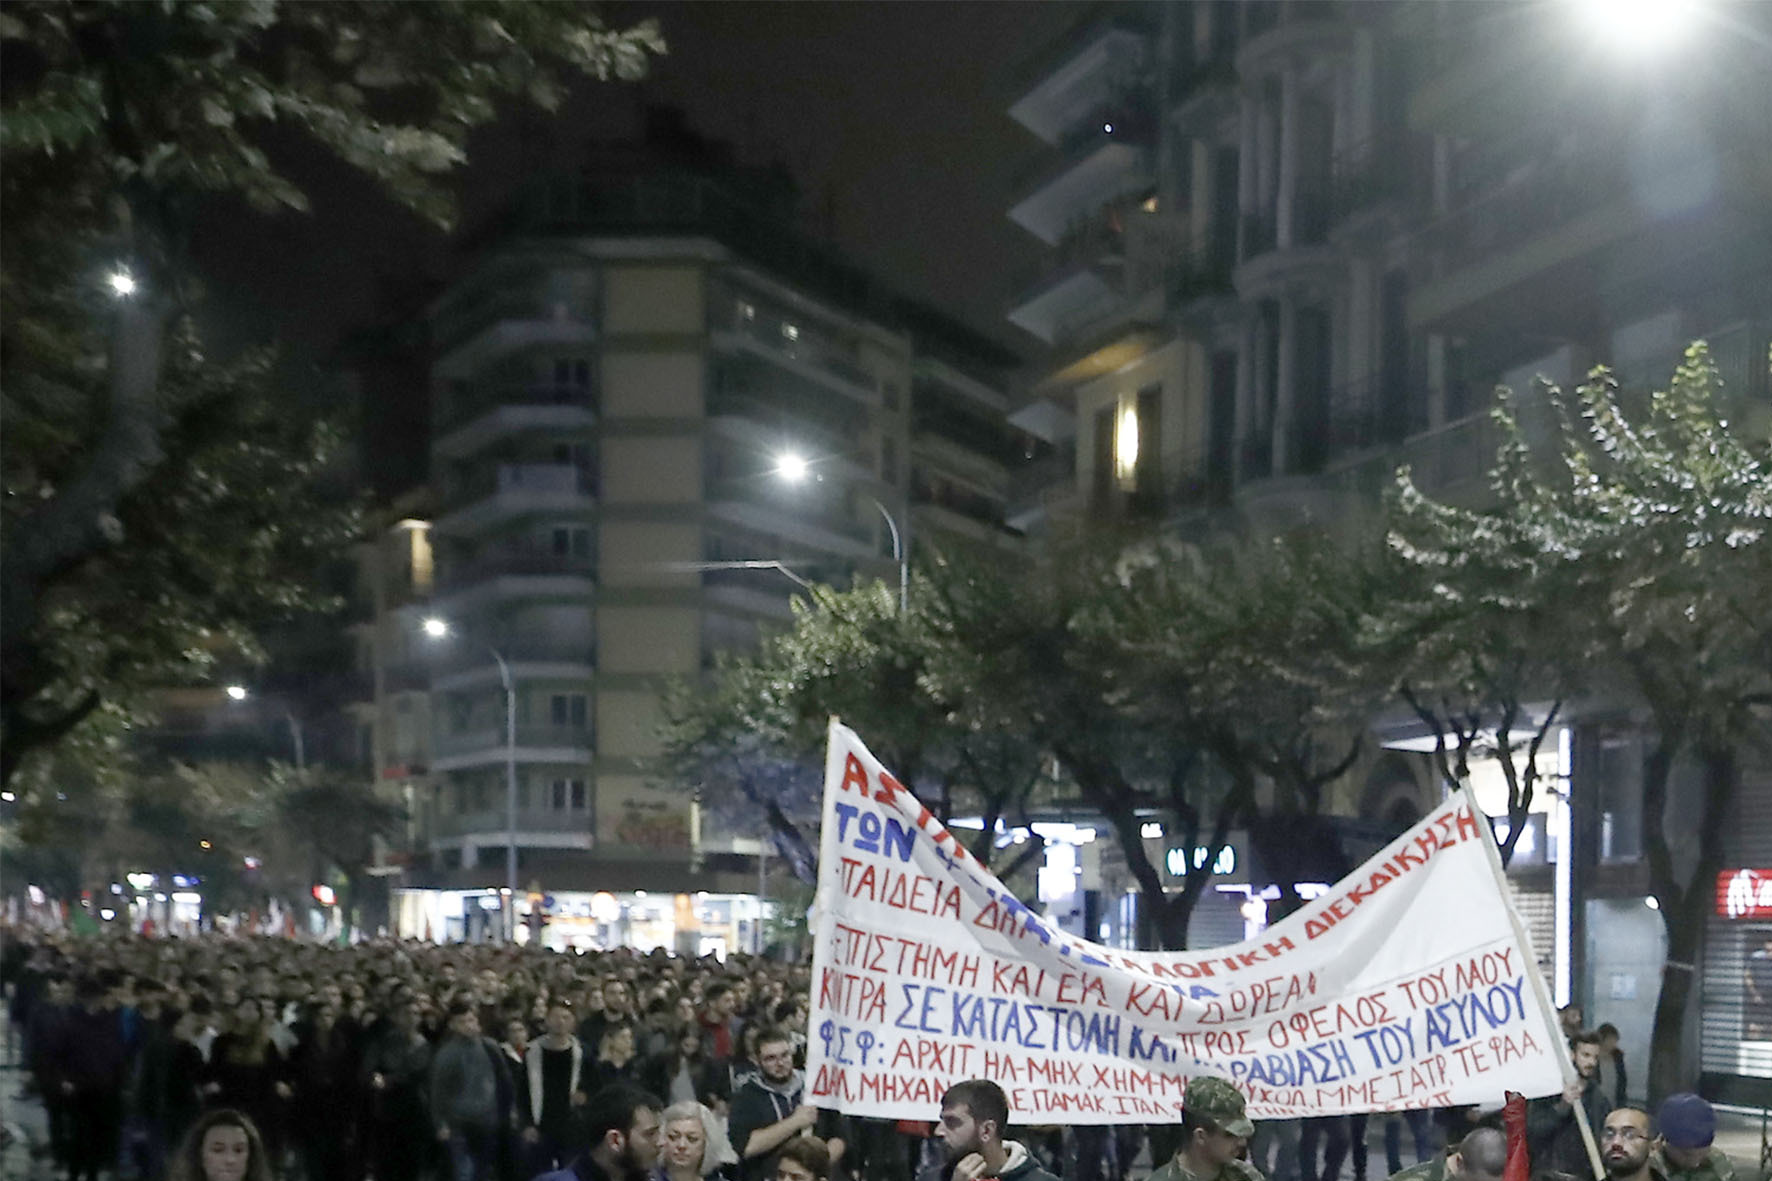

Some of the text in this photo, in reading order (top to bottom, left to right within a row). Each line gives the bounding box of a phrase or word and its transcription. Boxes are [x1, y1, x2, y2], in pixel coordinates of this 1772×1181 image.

[835, 802, 917, 863] ΤΩΝ
[1304, 803, 1481, 940] ΔΙΕΚΔΙΚΗΣΗ
[841, 856, 960, 920] ΠΑΙΔΕΙΑ
[894, 983, 945, 1034] ΣΕ
[951, 990, 1121, 1057] ΚΑΤΑΣΤΟΛΗ
[1353, 1016, 1416, 1070] ΤΟΥ
[1425, 974, 1526, 1053] ΑΣΥΛΟΥ
[993, 959, 1045, 999] ΚΑΙ
[1176, 1029, 1257, 1058] ΠΡΟΣ
[1268, 992, 1396, 1049] ΟΦΕΛΟΣ
[1397, 967, 1449, 1009] ΤΟΥ
[1456, 947, 1512, 993] ΛΑΟΥ
